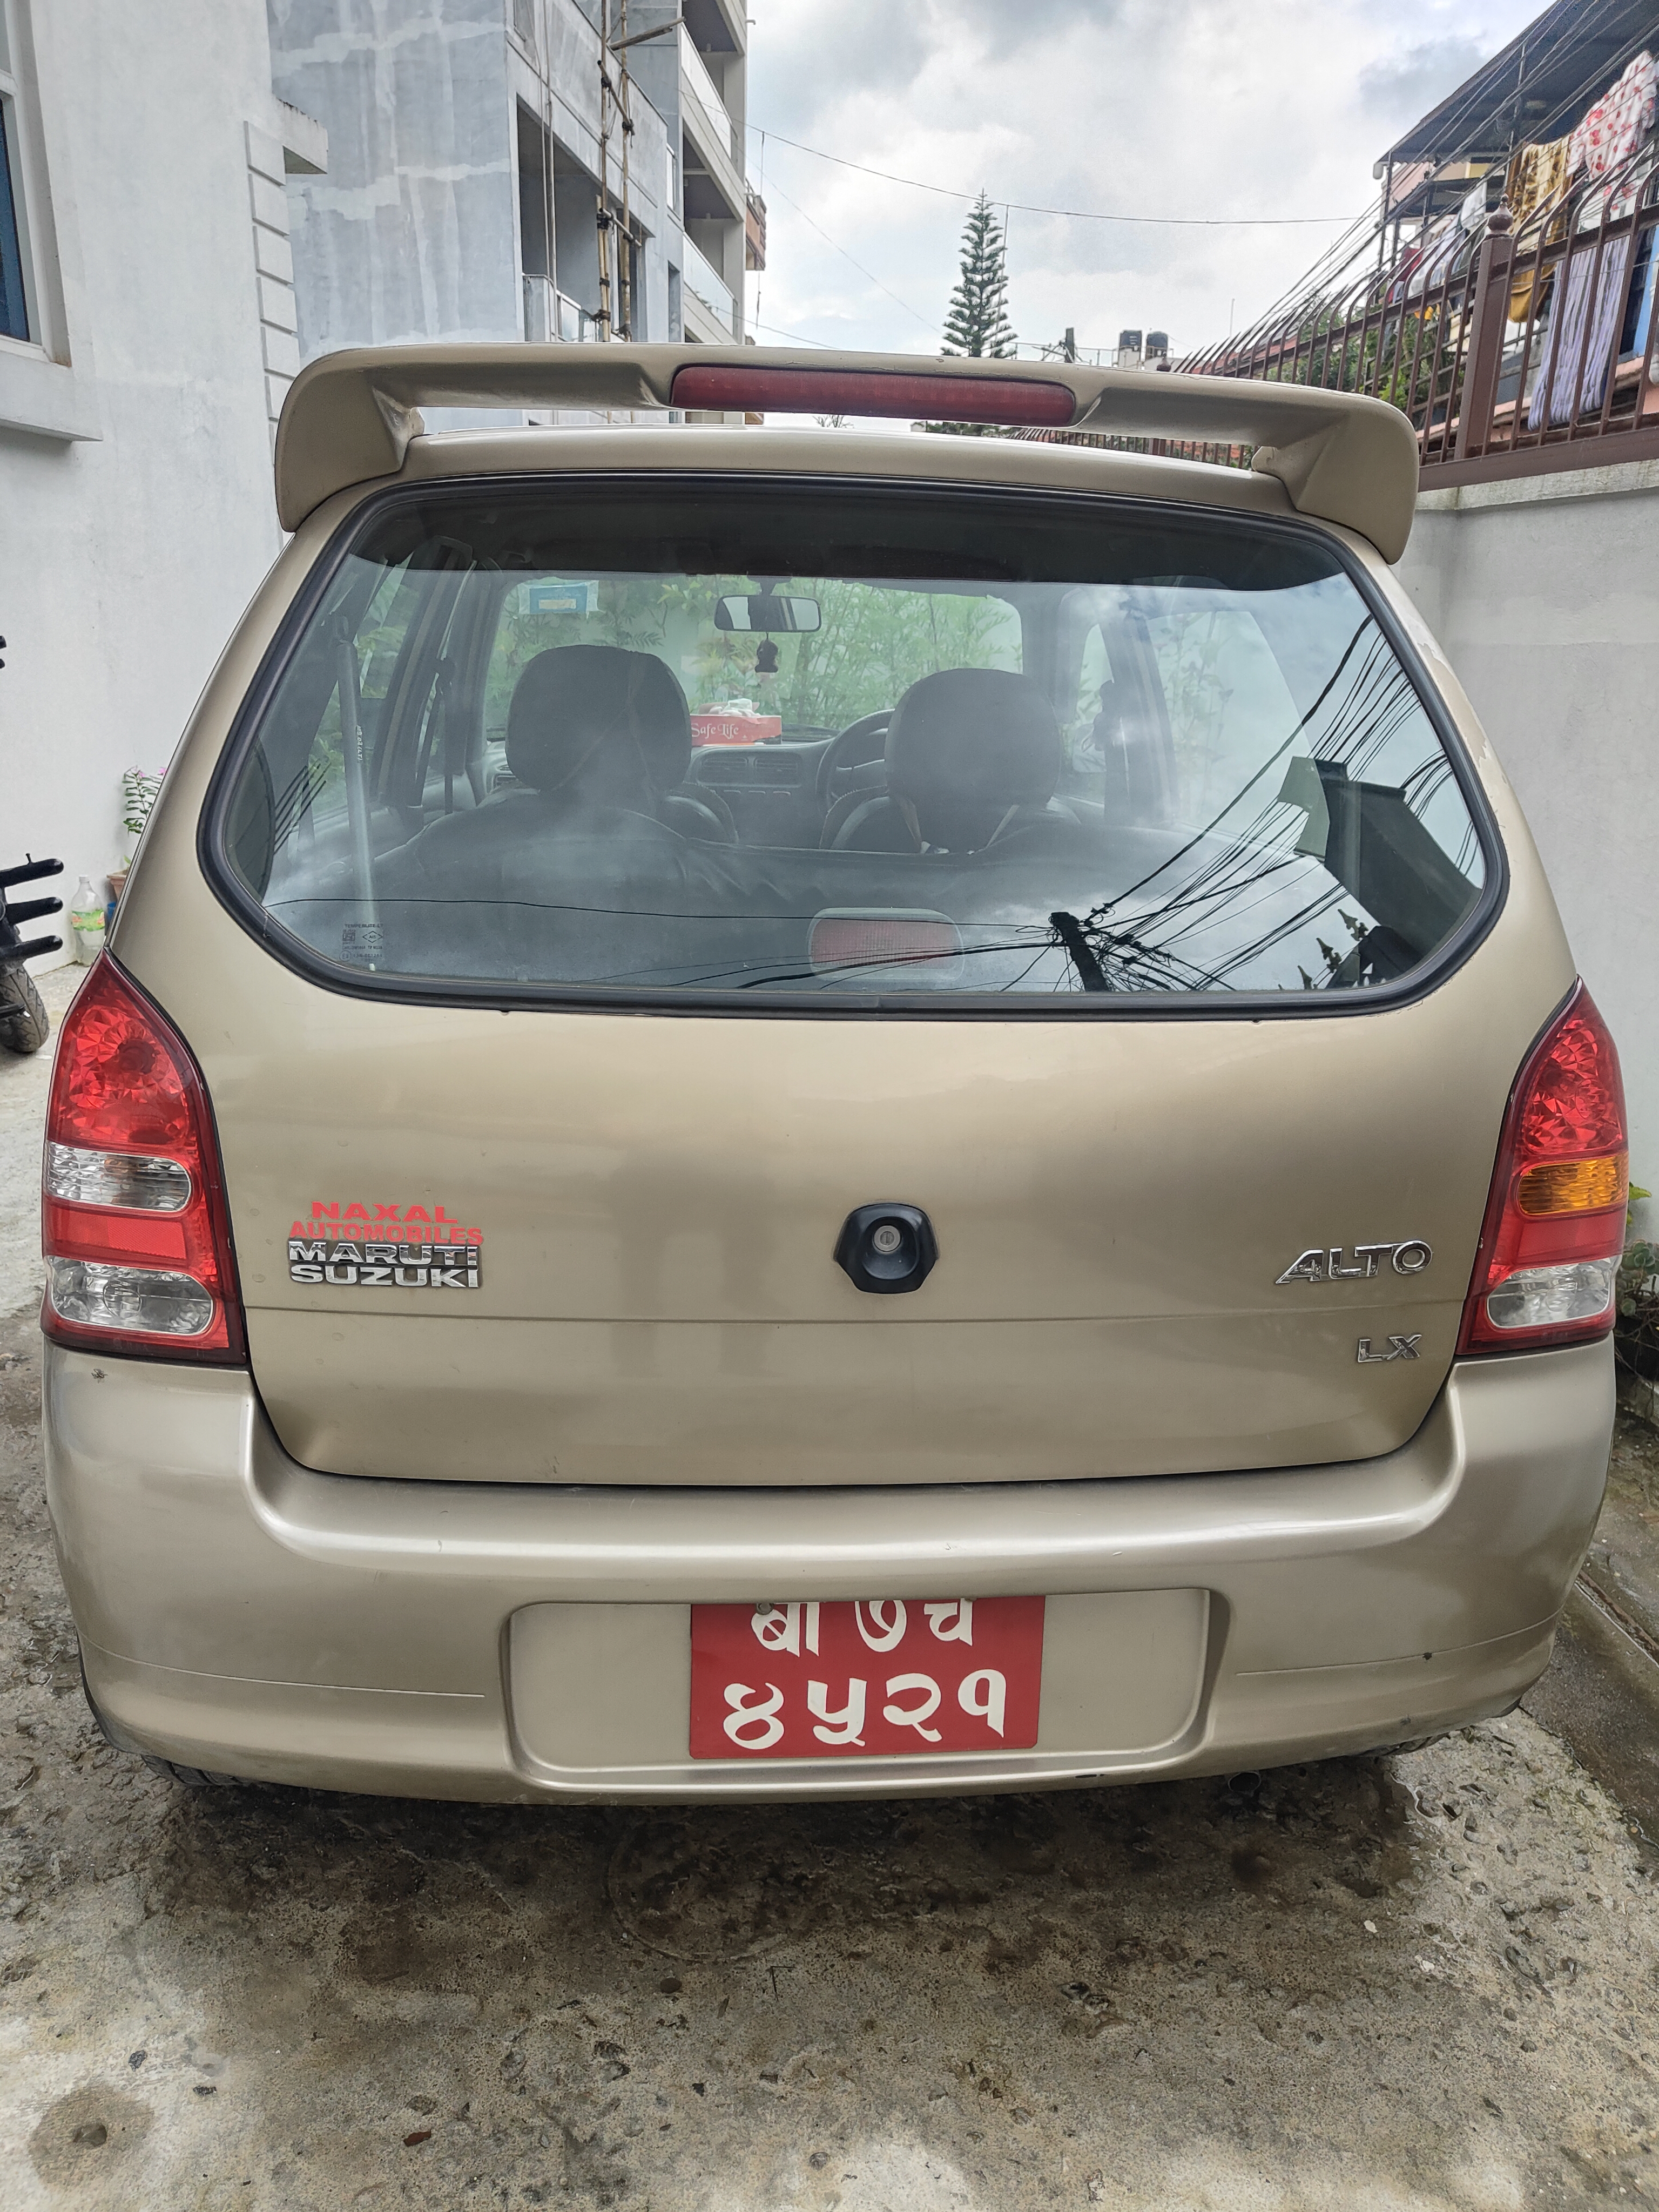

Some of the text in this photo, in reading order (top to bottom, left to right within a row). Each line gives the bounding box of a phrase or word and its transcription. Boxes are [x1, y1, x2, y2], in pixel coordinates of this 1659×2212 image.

[691, 723, 716, 739] Safe
[717, 724, 739, 739] Life
[312, 1201, 458, 1224] NAXAL
[289, 1221, 483, 1245] AUTOMOBILES
[289, 1240, 478, 1266] MARUTI
[1275, 1240, 1432, 1284] ALTO
[291, 1265, 479, 1288] SUZUKI
[1357, 1334, 1422, 1363] LX
